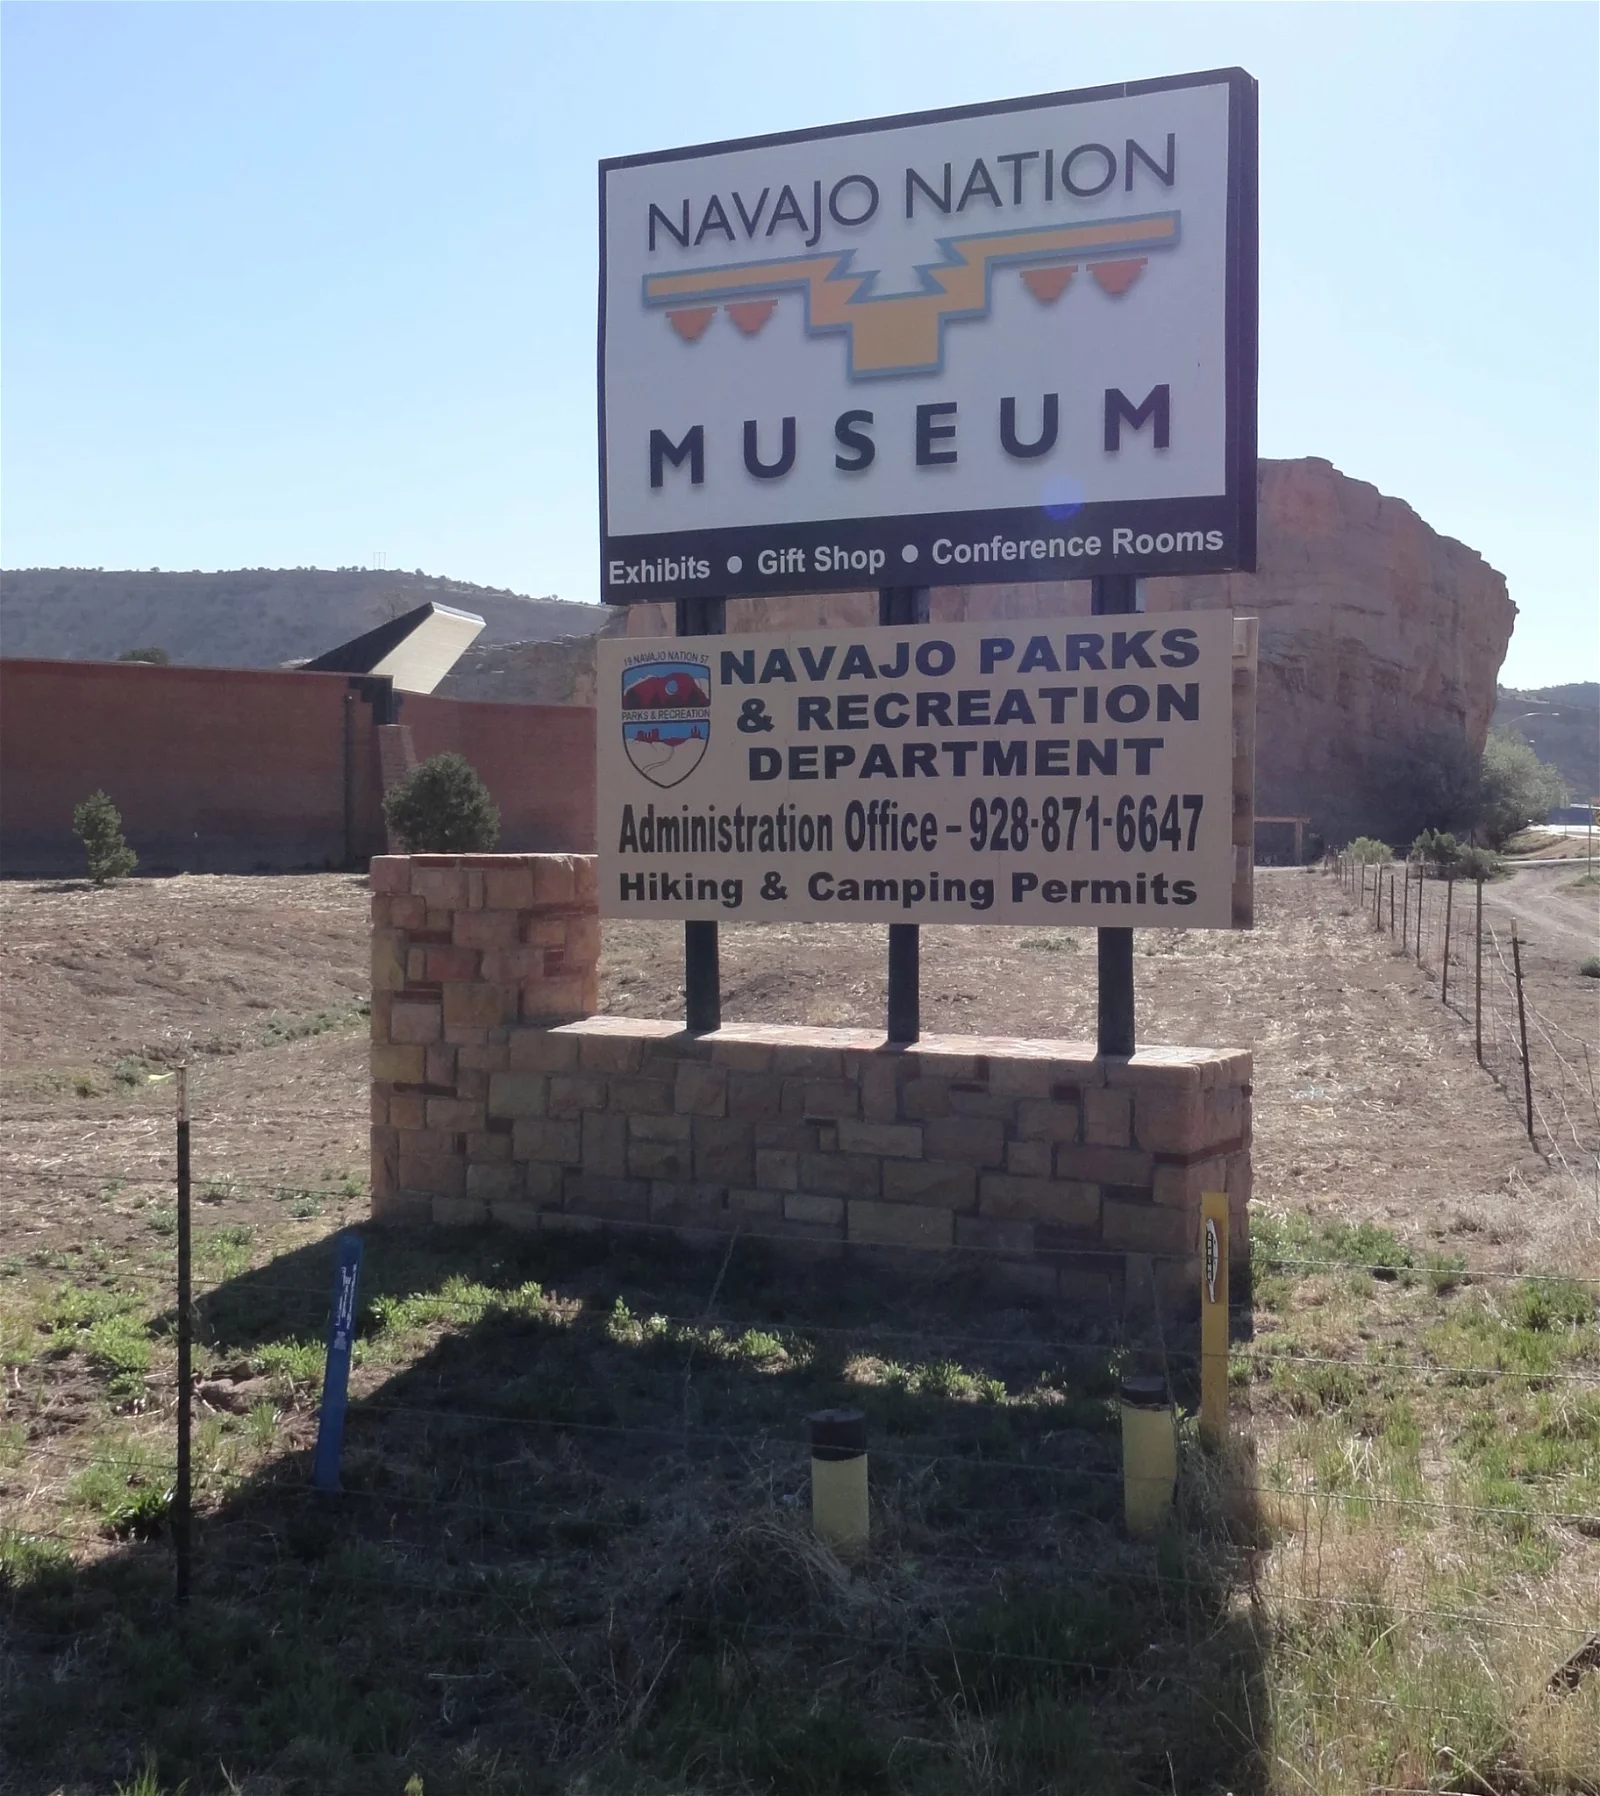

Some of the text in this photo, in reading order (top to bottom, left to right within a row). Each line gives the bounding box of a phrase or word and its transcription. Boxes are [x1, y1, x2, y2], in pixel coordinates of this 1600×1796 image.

[648, 133, 1176, 252] NAVAJO NATION
[649, 384, 1170, 488] MUSEUM
[609, 528, 1223, 584] Exhibits Gift Shop Conference Rooms
[634, 652, 666, 664] NAVAJO
[668, 651, 698, 661] NATION
[721, 629, 1199, 685] NAVAJO PARKS
[622, 711, 648, 721] PARKS
[658, 709, 710, 720] RECREATION
[737, 683, 1199, 733] & RECREATION
[749, 738, 1164, 781] DEPARTMENT
[619, 803, 833, 853] Administration
[845, 799, 937, 852] Office
[970, 795, 1203, 852] 928-871-6647
[620, 871, 1197, 910] Hiking & Camping Permits
